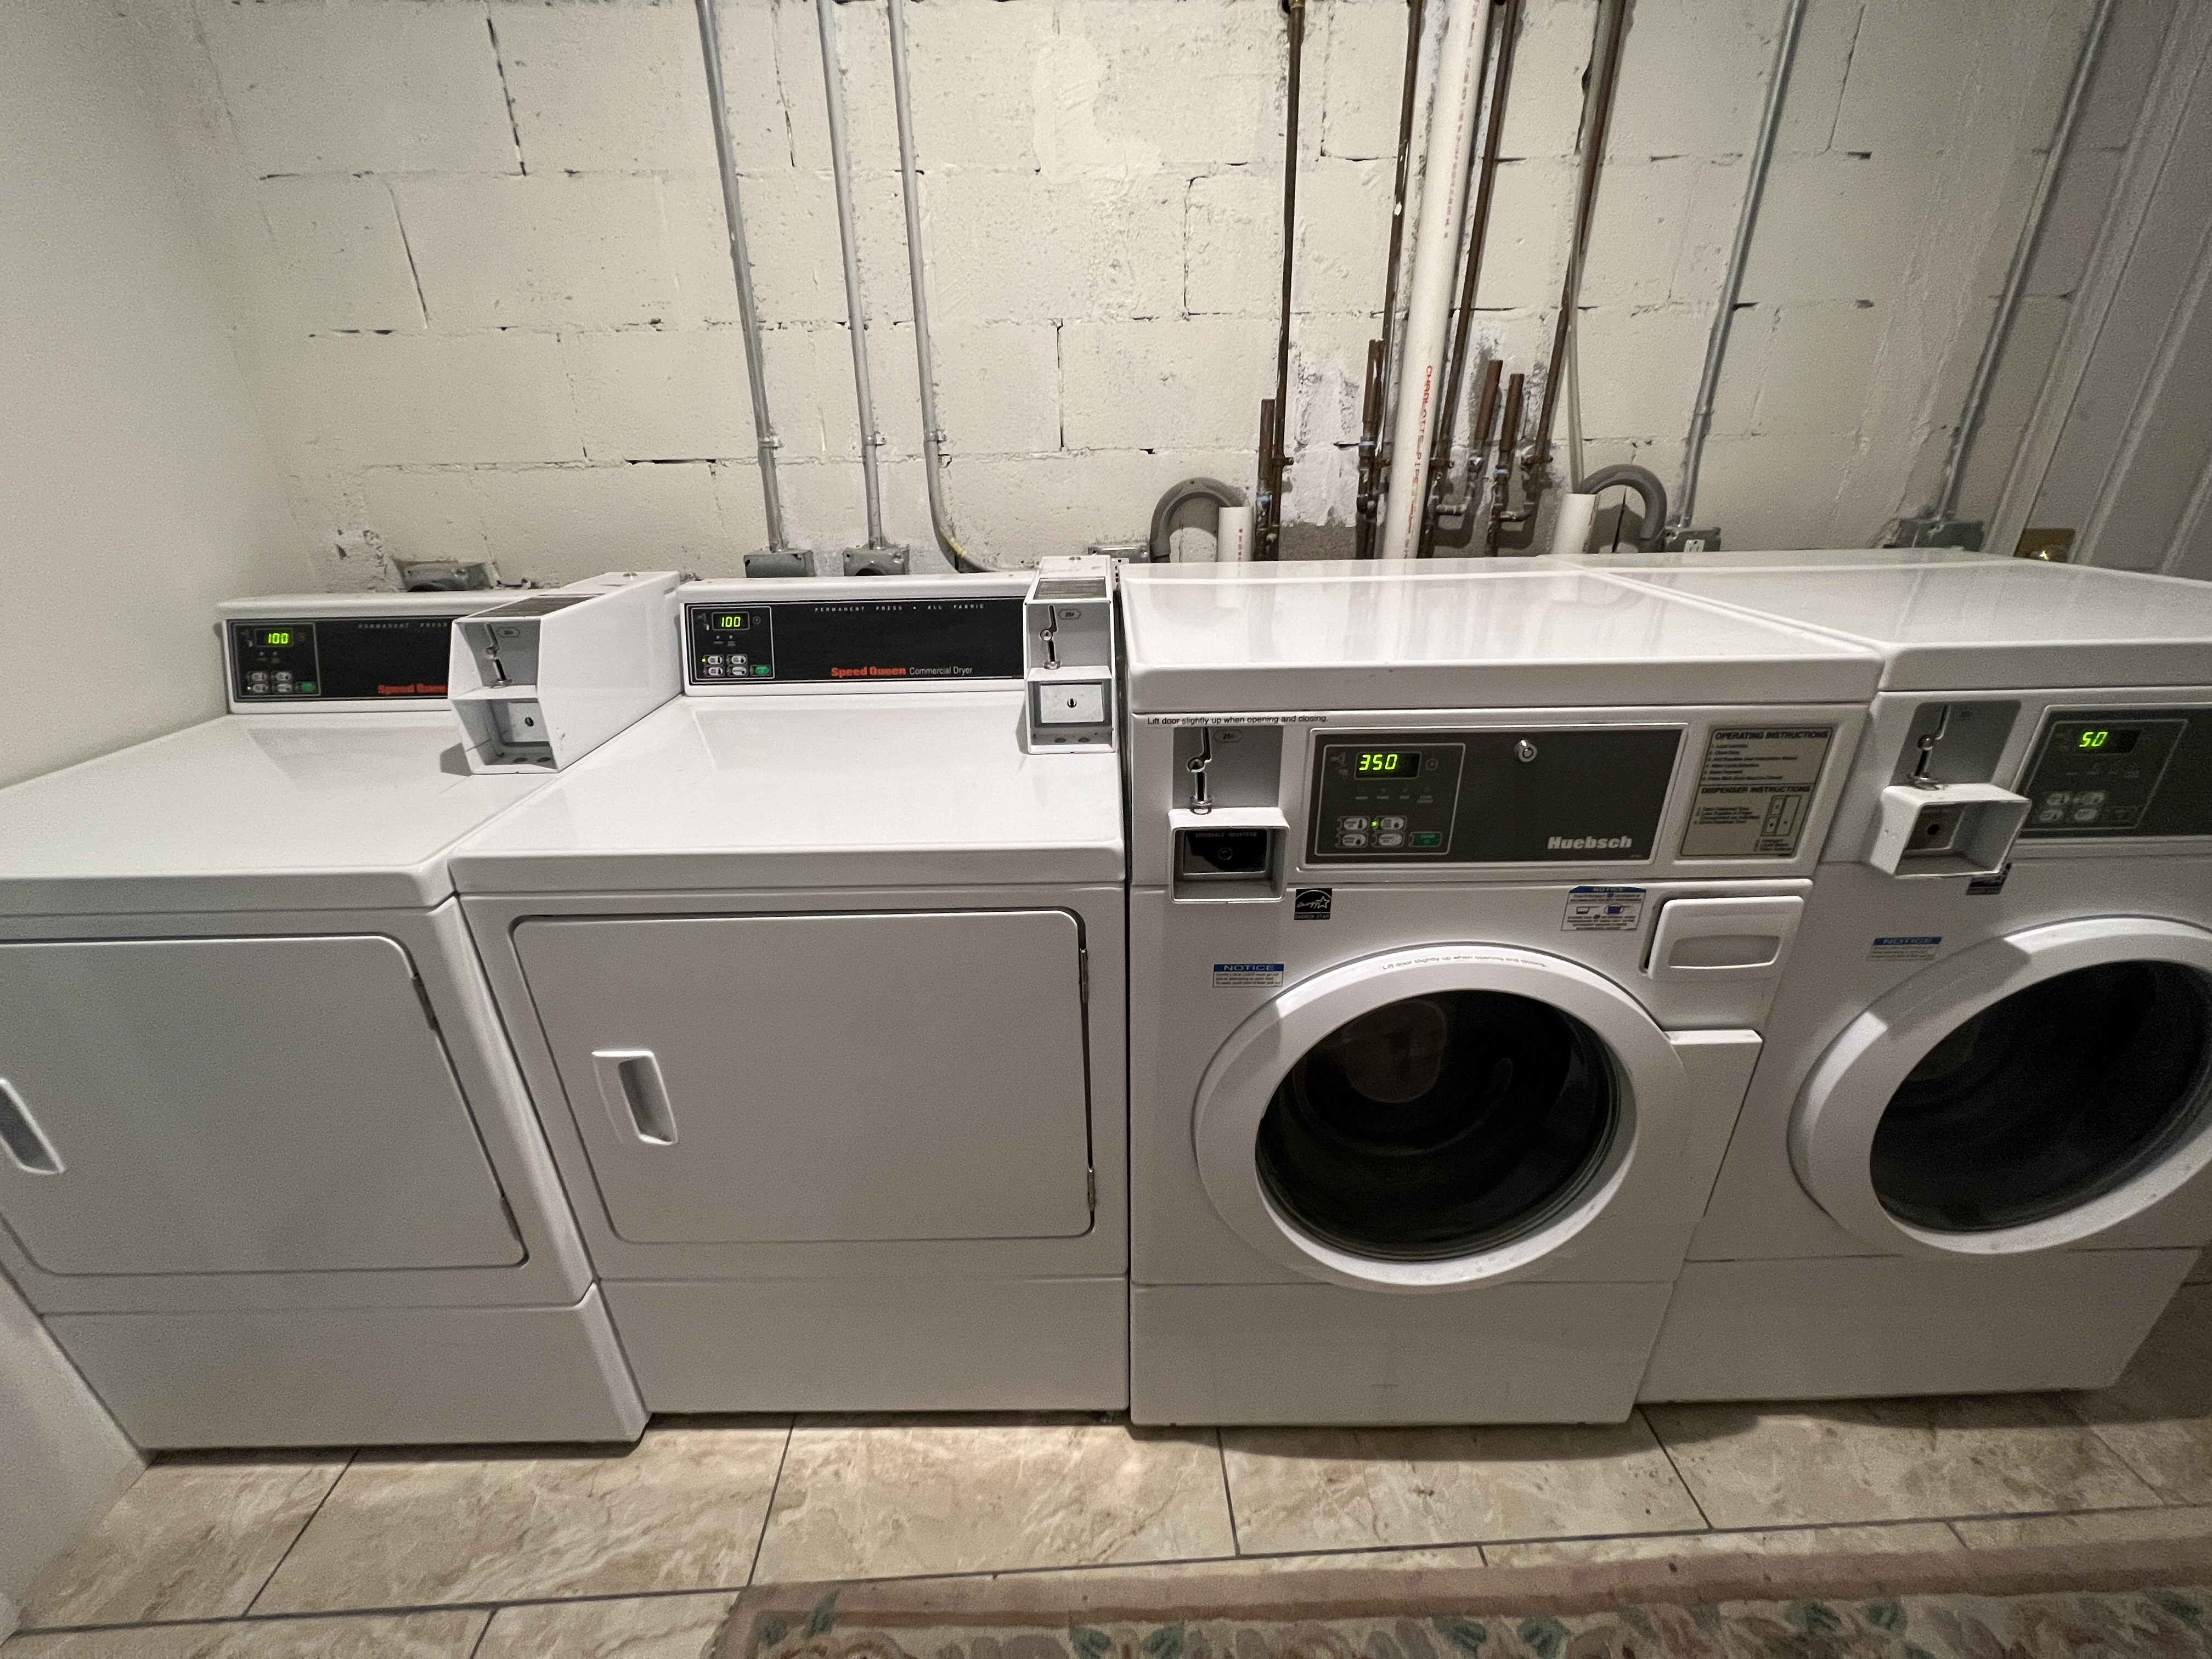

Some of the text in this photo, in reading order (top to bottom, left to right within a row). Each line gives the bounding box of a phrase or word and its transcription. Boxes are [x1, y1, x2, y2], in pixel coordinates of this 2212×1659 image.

[721, 616, 741, 628] 100
[268, 633, 289, 644] 100
[831, 666, 973, 678] Speed Queen Commercial Dryer
[1182, 716, 1209, 725] slightly
[1246, 715, 1279, 724] opening
[1715, 731, 1829, 740] OPERATING INSTRUCTIONS
[2079, 731, 2108, 747] 50
[1359, 754, 1398, 771] 350
[1701, 786, 1811, 794] DISPENSER INSTRUCTIONS
[1547, 835, 1633, 849] Huebsch
